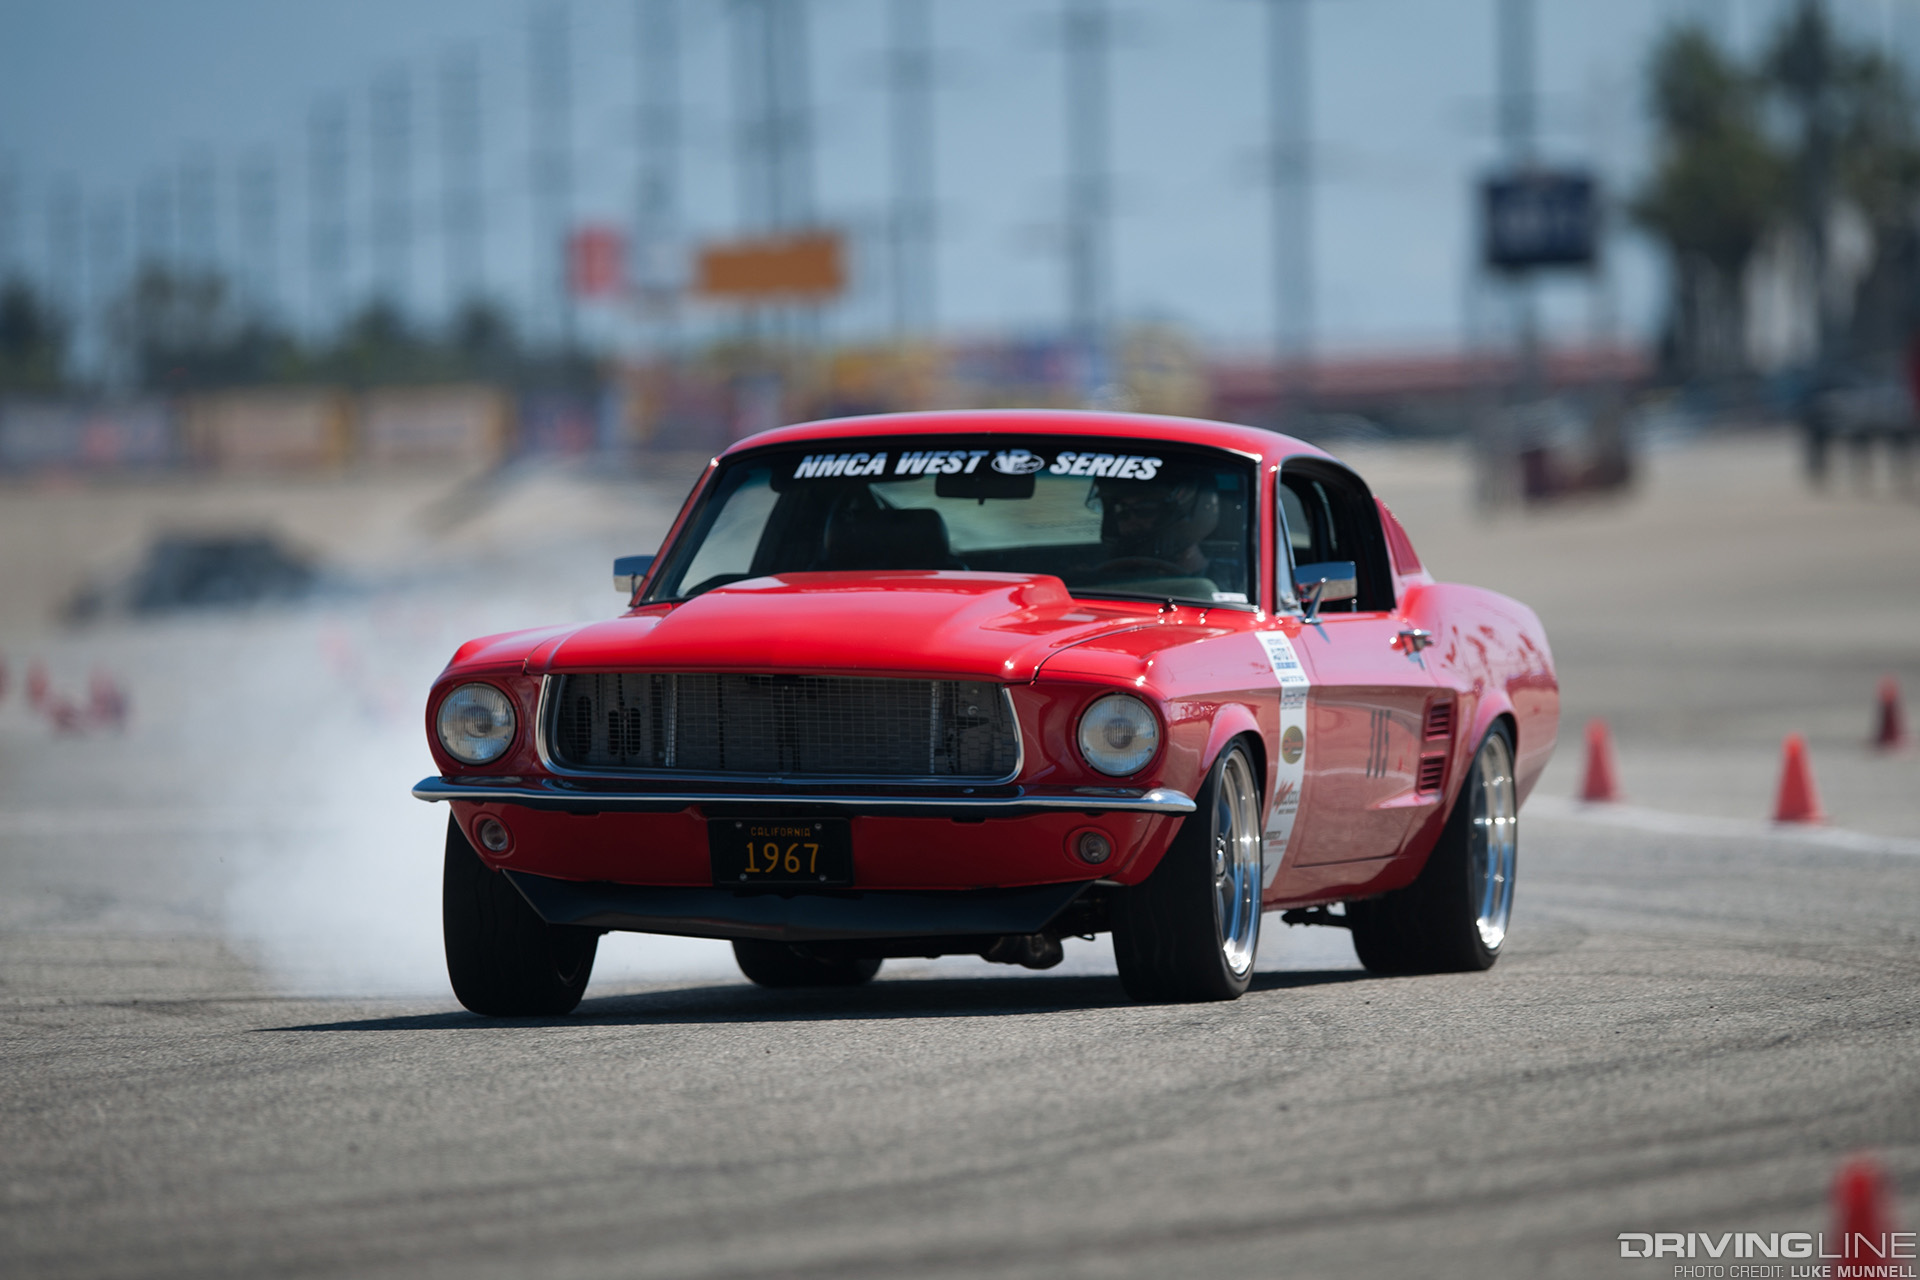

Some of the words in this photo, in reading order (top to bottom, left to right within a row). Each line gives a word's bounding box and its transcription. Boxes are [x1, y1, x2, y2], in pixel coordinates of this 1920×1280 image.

[793, 452, 888, 480] NMCA
[894, 450, 989, 475] WEST
[1049, 451, 1163, 480] SERIES
[751, 826, 811, 837] CALIFORNIA
[744, 841, 819, 874] 1967
